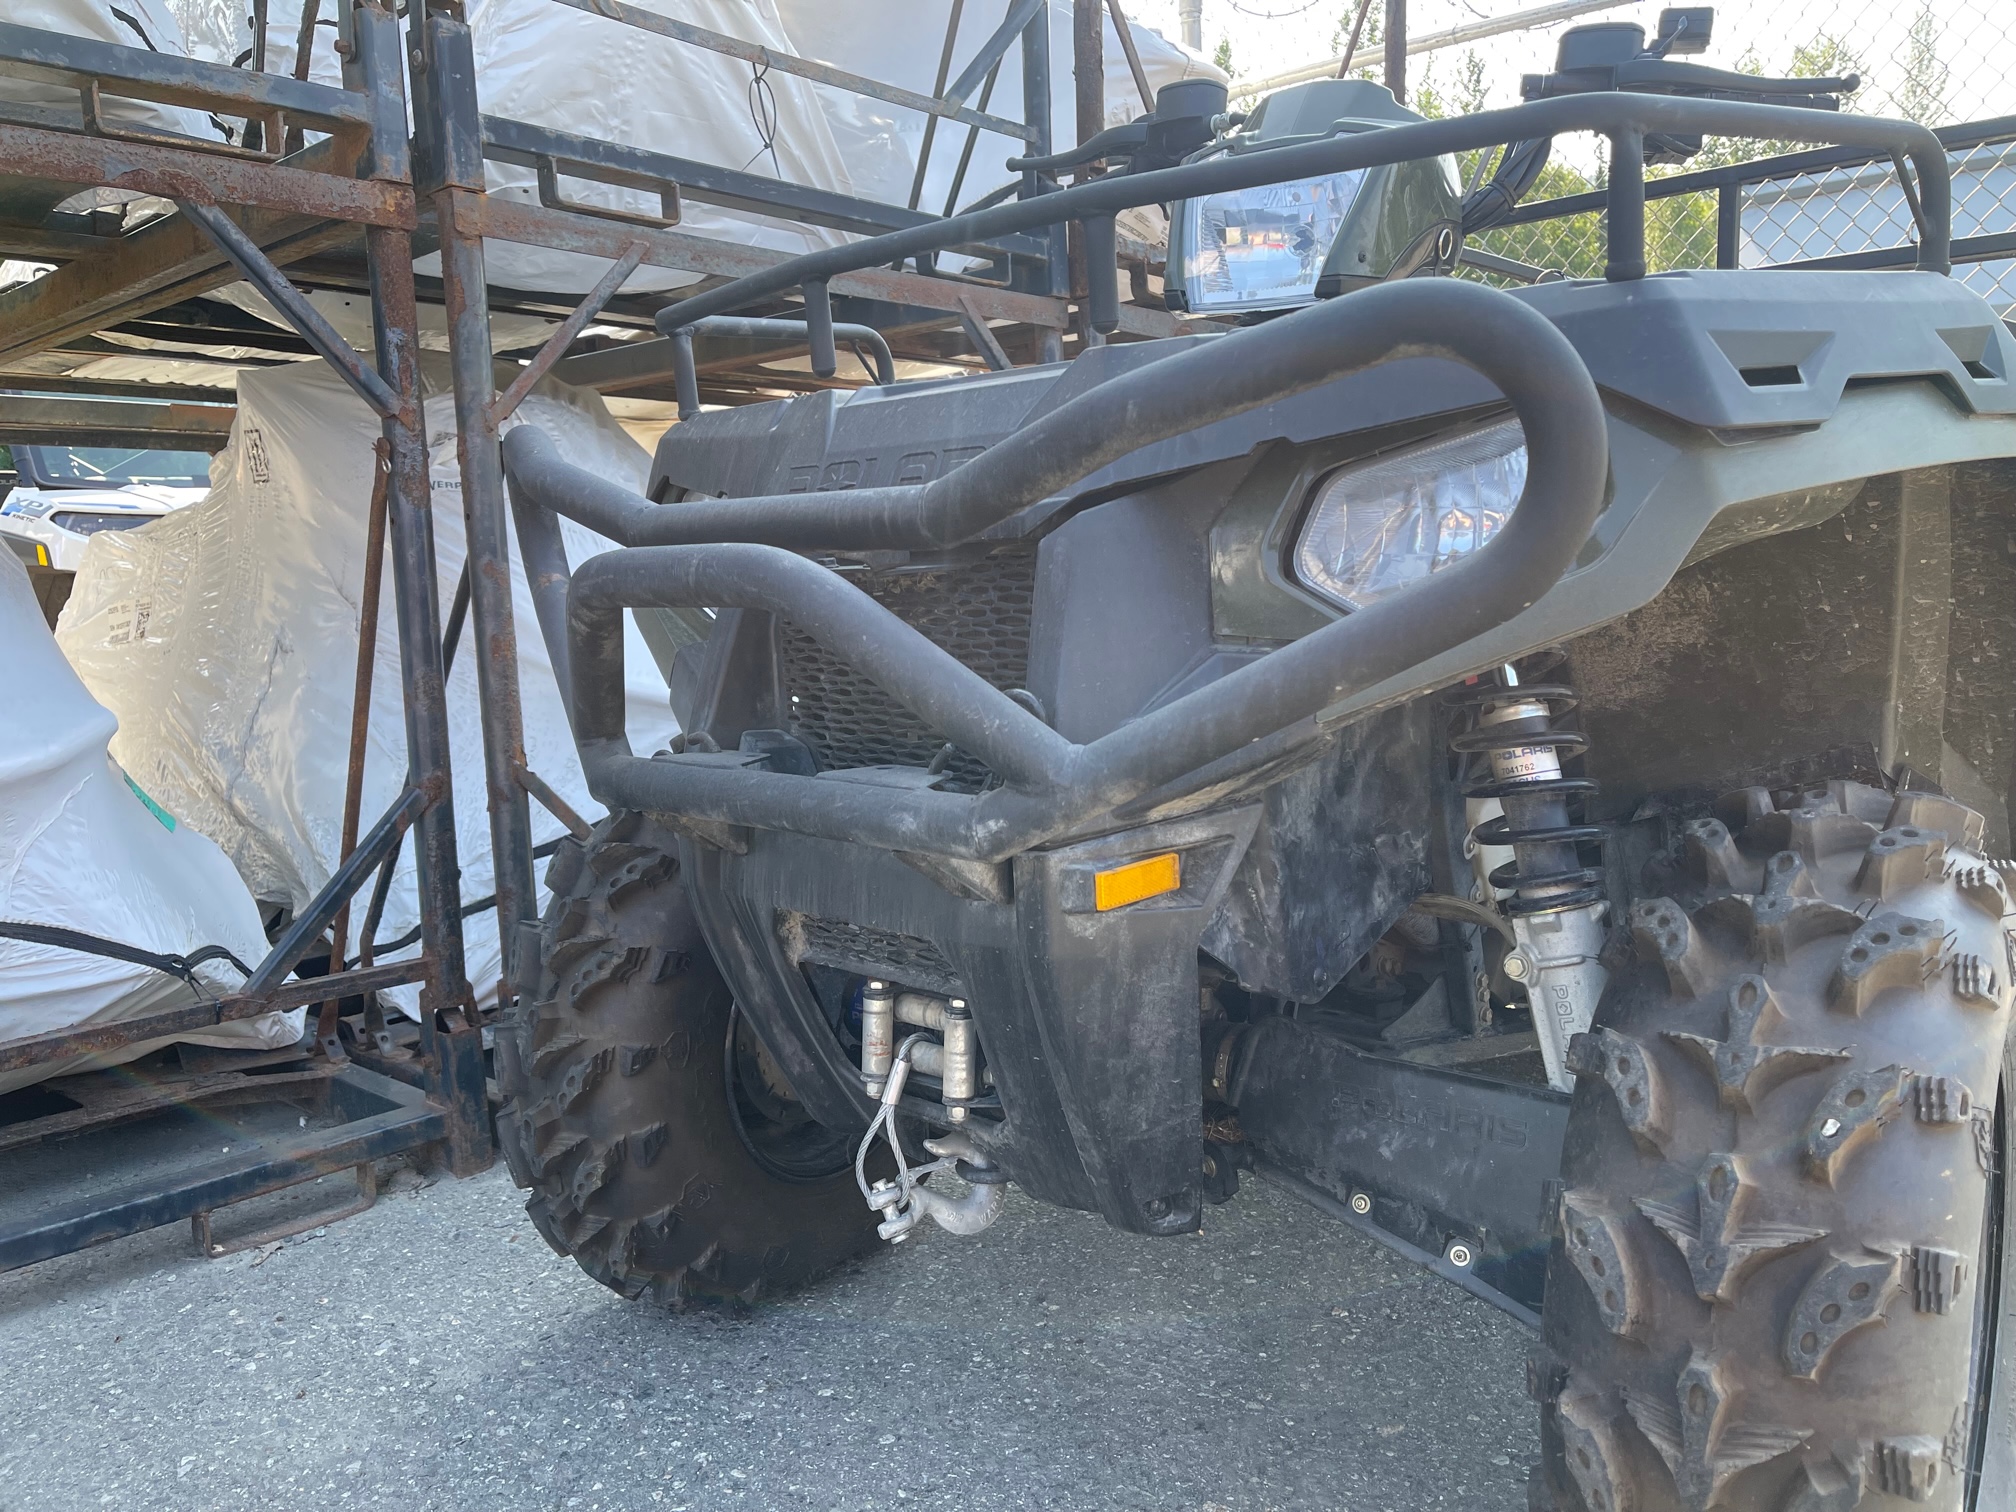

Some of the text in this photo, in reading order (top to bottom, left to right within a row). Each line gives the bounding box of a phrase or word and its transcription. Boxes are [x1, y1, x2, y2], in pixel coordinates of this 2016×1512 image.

[11, 513, 36, 524] KINETIC
[1494, 745, 1553, 762] POLARIS
[1501, 763, 1536, 776] 7041762
[978, 1190, 1003, 1225] WARN
